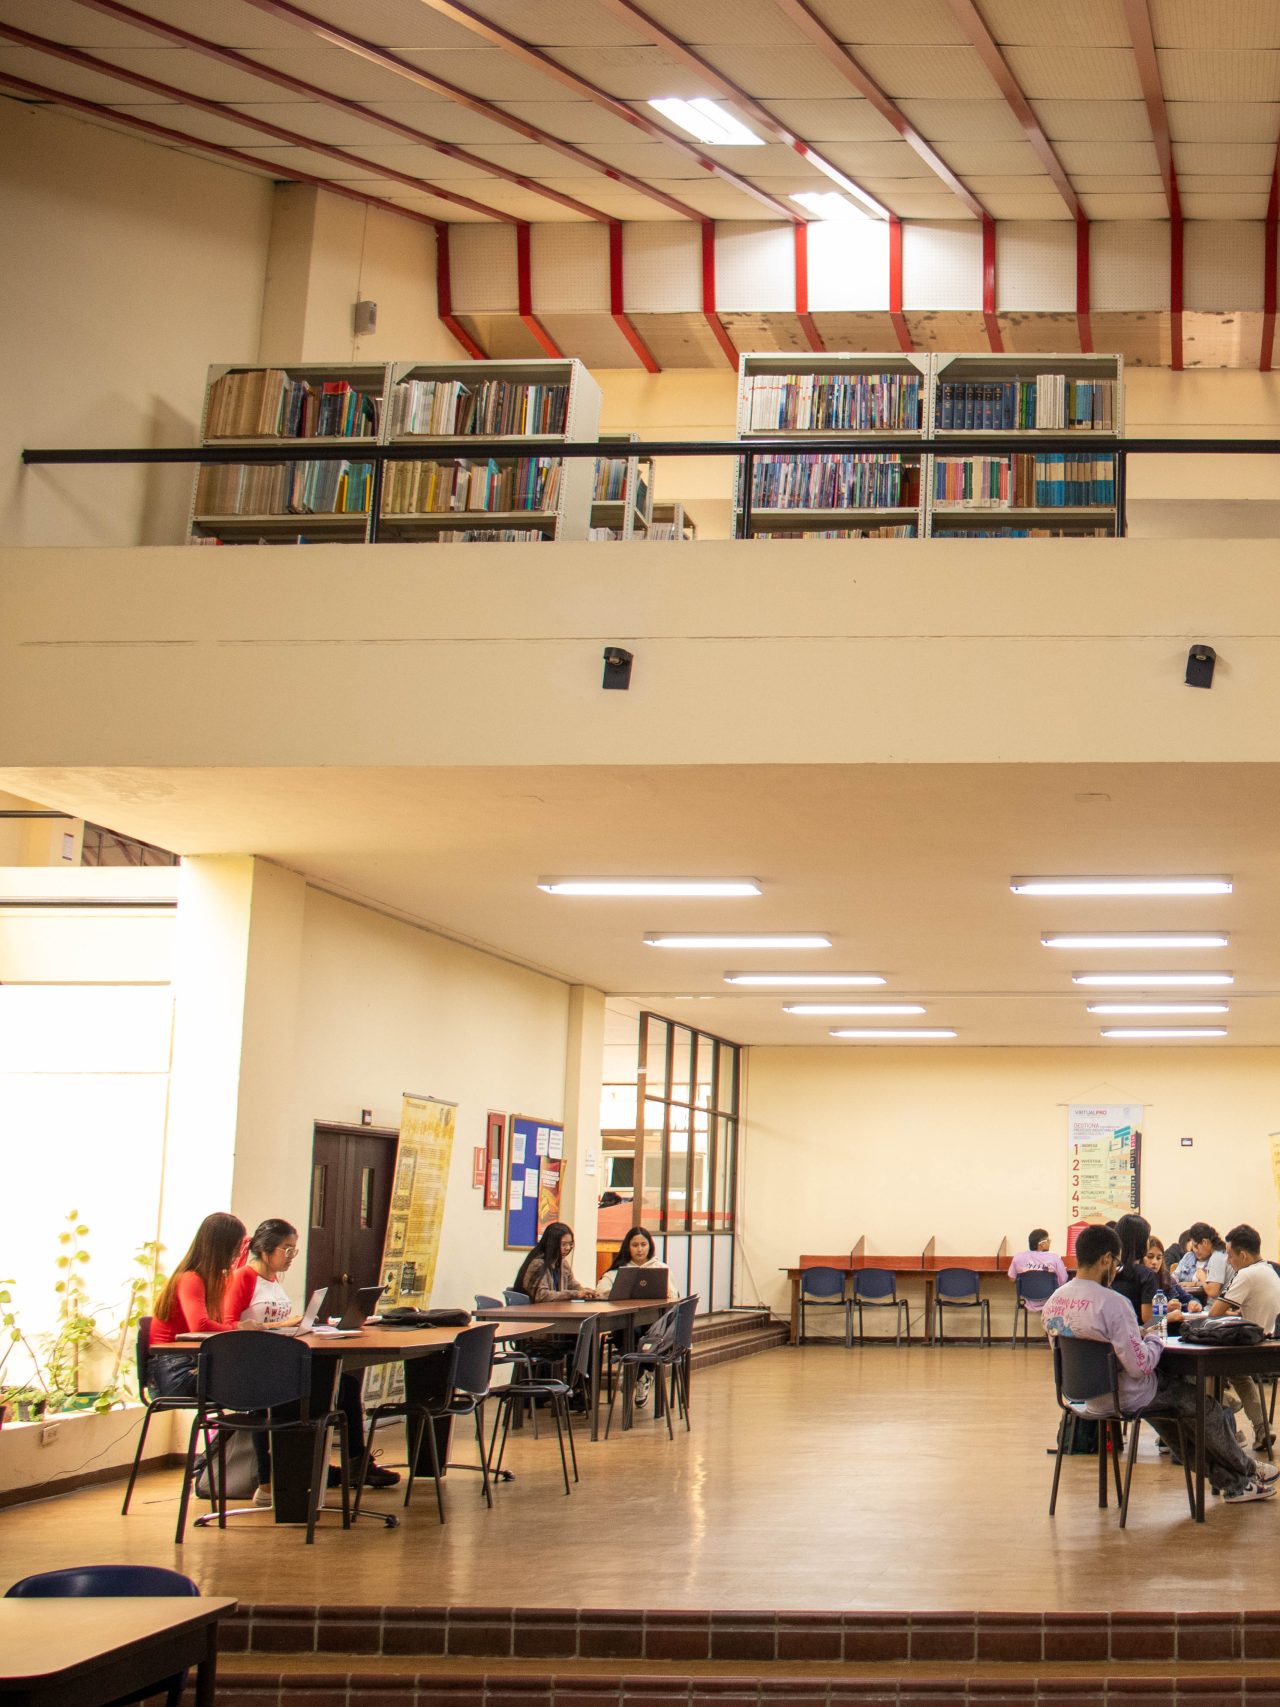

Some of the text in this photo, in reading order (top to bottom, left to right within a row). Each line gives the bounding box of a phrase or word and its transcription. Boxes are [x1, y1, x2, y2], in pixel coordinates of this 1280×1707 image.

[1073, 1143, 1079, 1155] 1
[1072, 1159, 1080, 1171] 2
[1072, 1175, 1079, 1187] 3
[1072, 1190, 1080, 1202] 4
[1072, 1206, 1079, 1218] 5
